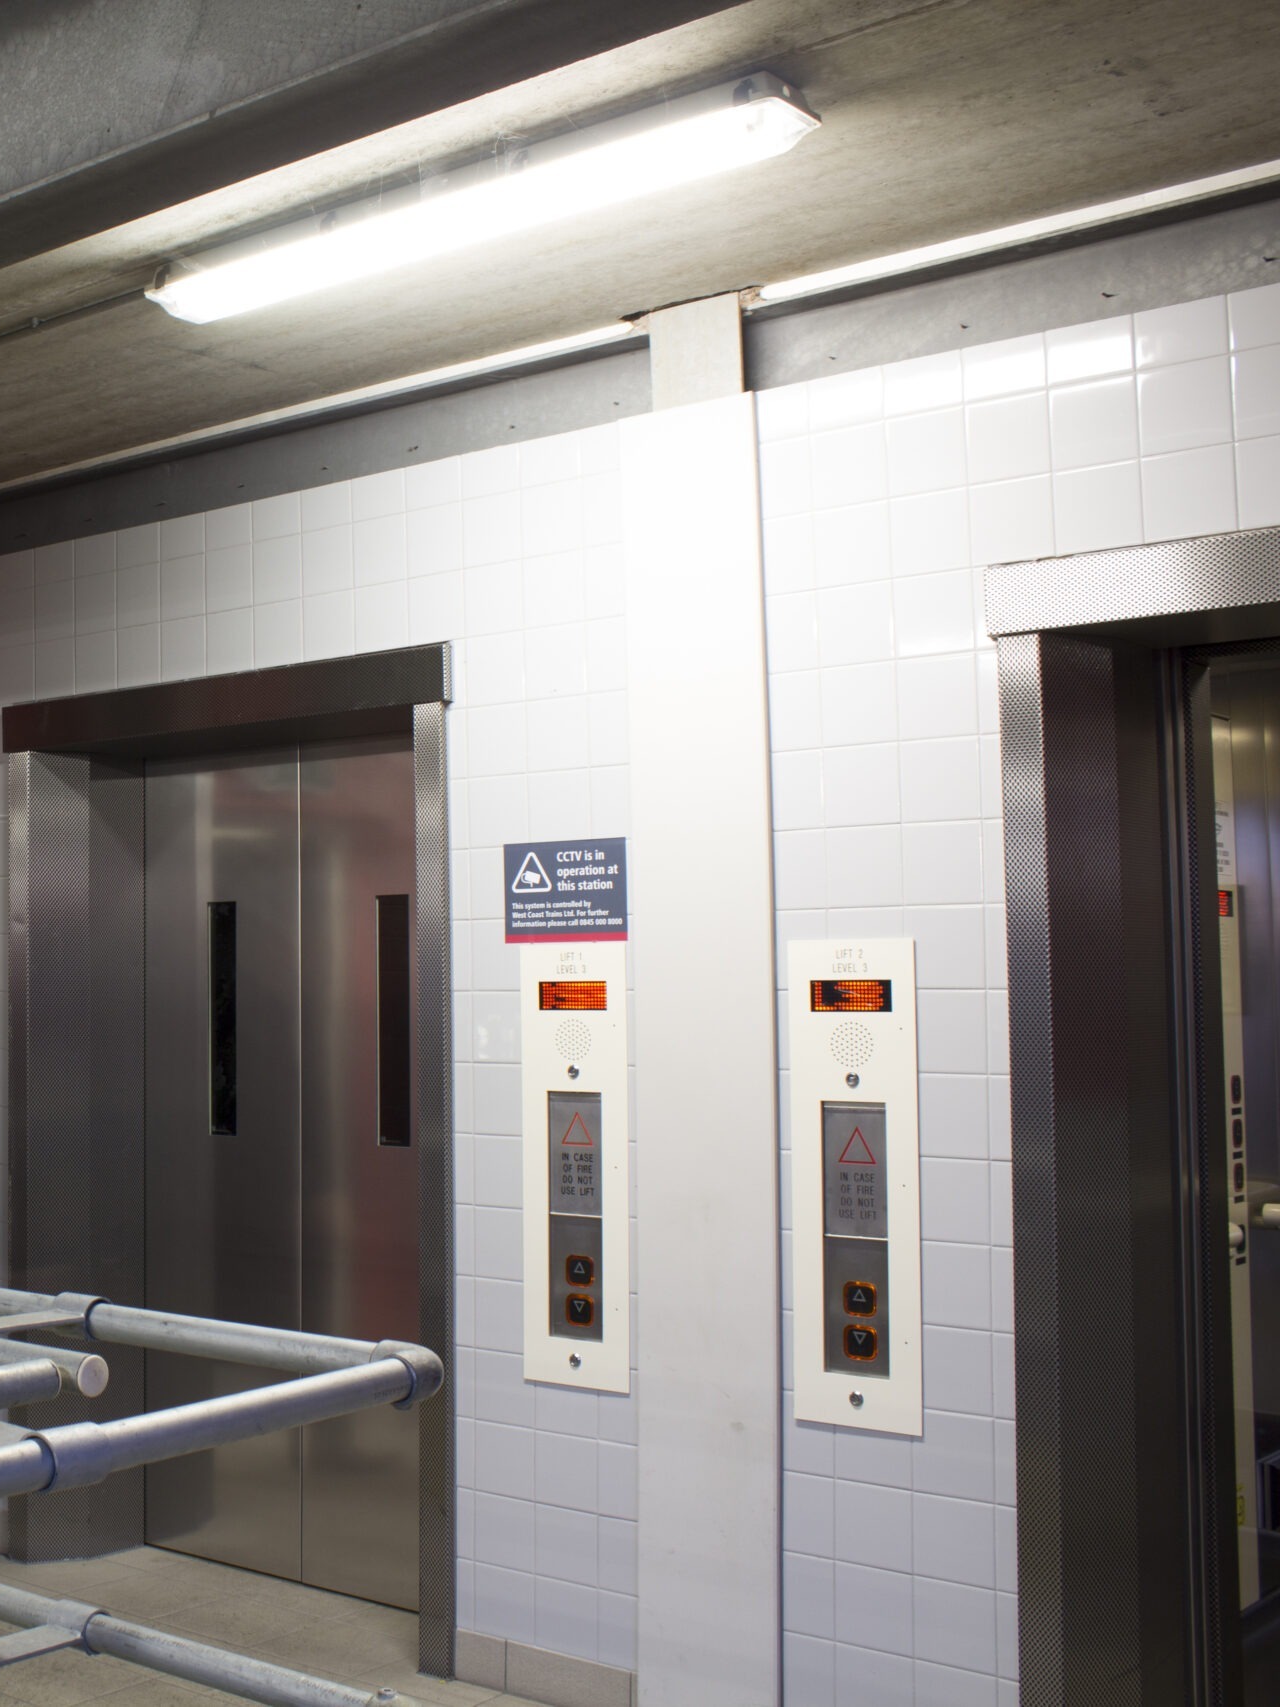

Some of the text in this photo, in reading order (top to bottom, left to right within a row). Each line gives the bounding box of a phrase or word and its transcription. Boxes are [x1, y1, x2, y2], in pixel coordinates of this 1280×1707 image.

[556, 849, 605, 862] CCTV is in
[557, 864, 619, 879] operation at
[557, 879, 613, 892] this station
[512, 899, 592, 911] This system is controlled by
[545, 910, 563, 918] Trains
[576, 909, 586, 917] For
[587, 908, 610, 916] further
[512, 920, 547, 928] information
[547, 919, 567, 928] please
[568, 918, 579, 926] call
[560, 952, 575, 962] LIFT
[835, 949, 864, 959] LIFT 2
[556, 965, 577, 974] LEVEL
[832, 962, 868, 973] LEVEL 3
[561, 1152, 594, 1163] IN CASE
[562, 1163, 593, 1174] OF FIRE
[562, 1174, 593, 1185] DO NOT
[839, 1171, 876, 1183] IN CASE
[560, 1186, 595, 1197] USE LIFT
[840, 1184, 875, 1196] OF FIRE
[840, 1196, 875, 1208] DO NOT
[838, 1208, 877, 1220] USE LIFT
